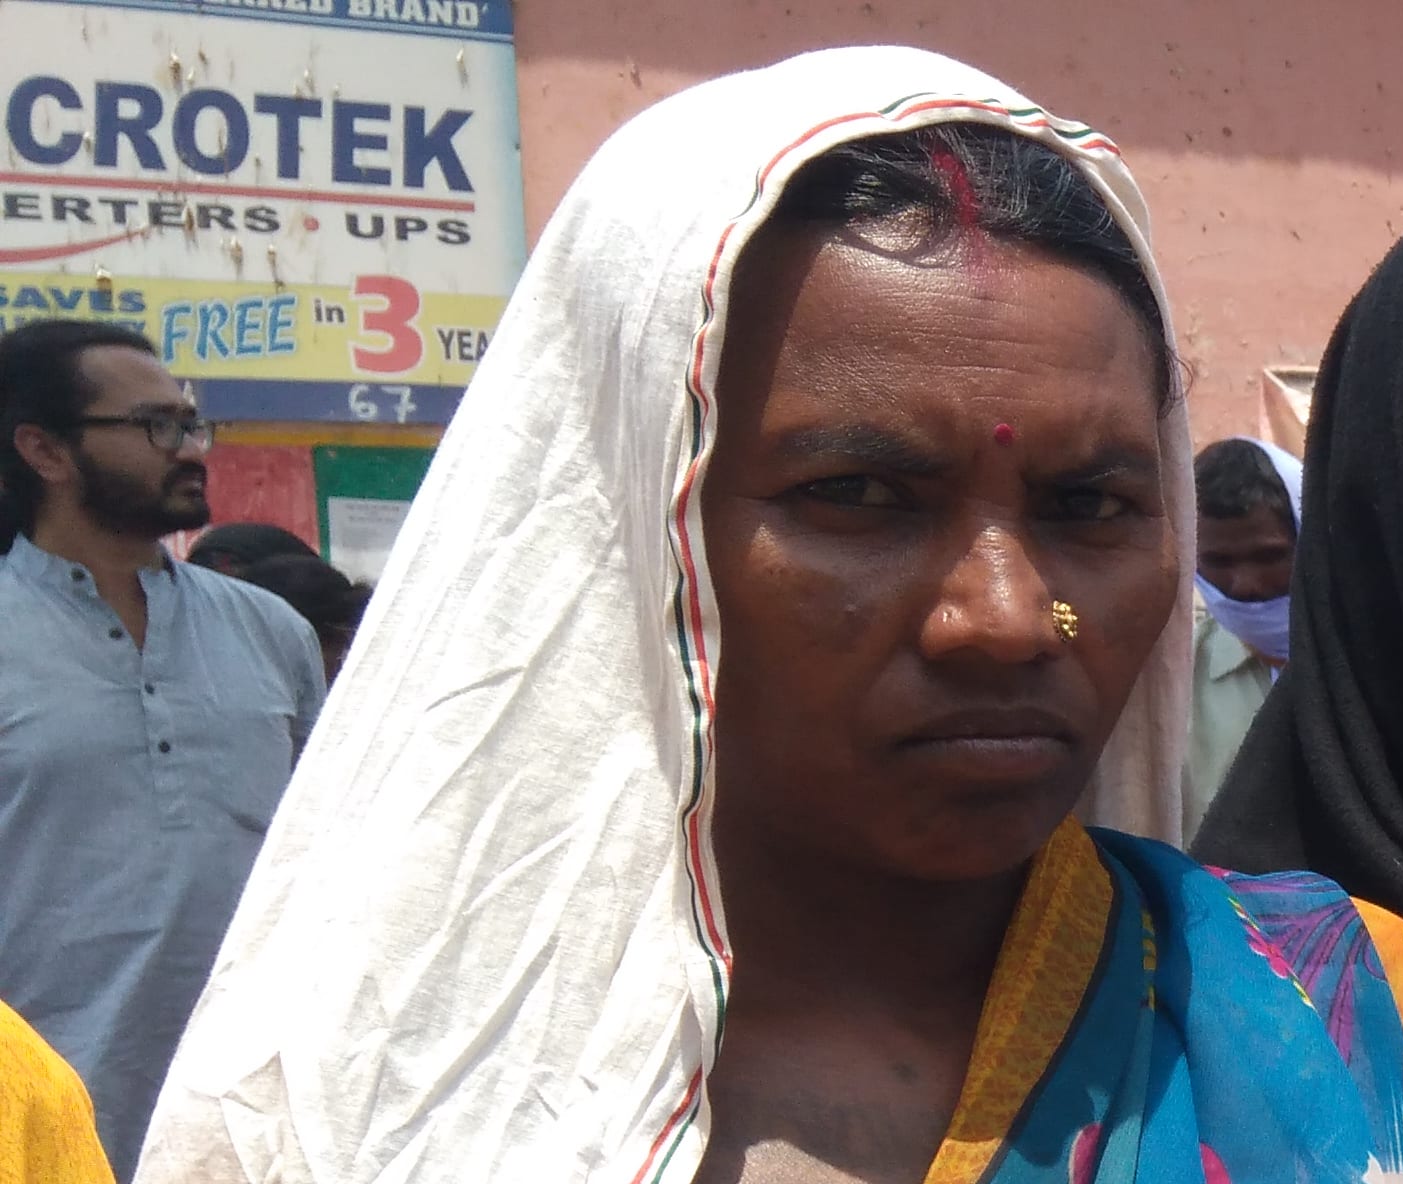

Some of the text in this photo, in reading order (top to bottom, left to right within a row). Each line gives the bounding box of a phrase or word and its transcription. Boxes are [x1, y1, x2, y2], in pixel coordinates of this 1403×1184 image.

[7, 76, 474, 192] CROTEK
[346, 213, 470, 245] UPS
[162, 296, 297, 362] FREE
[315, 299, 344, 323] in
[350, 275, 423, 373] 3
[349, 383, 415, 423] 67
